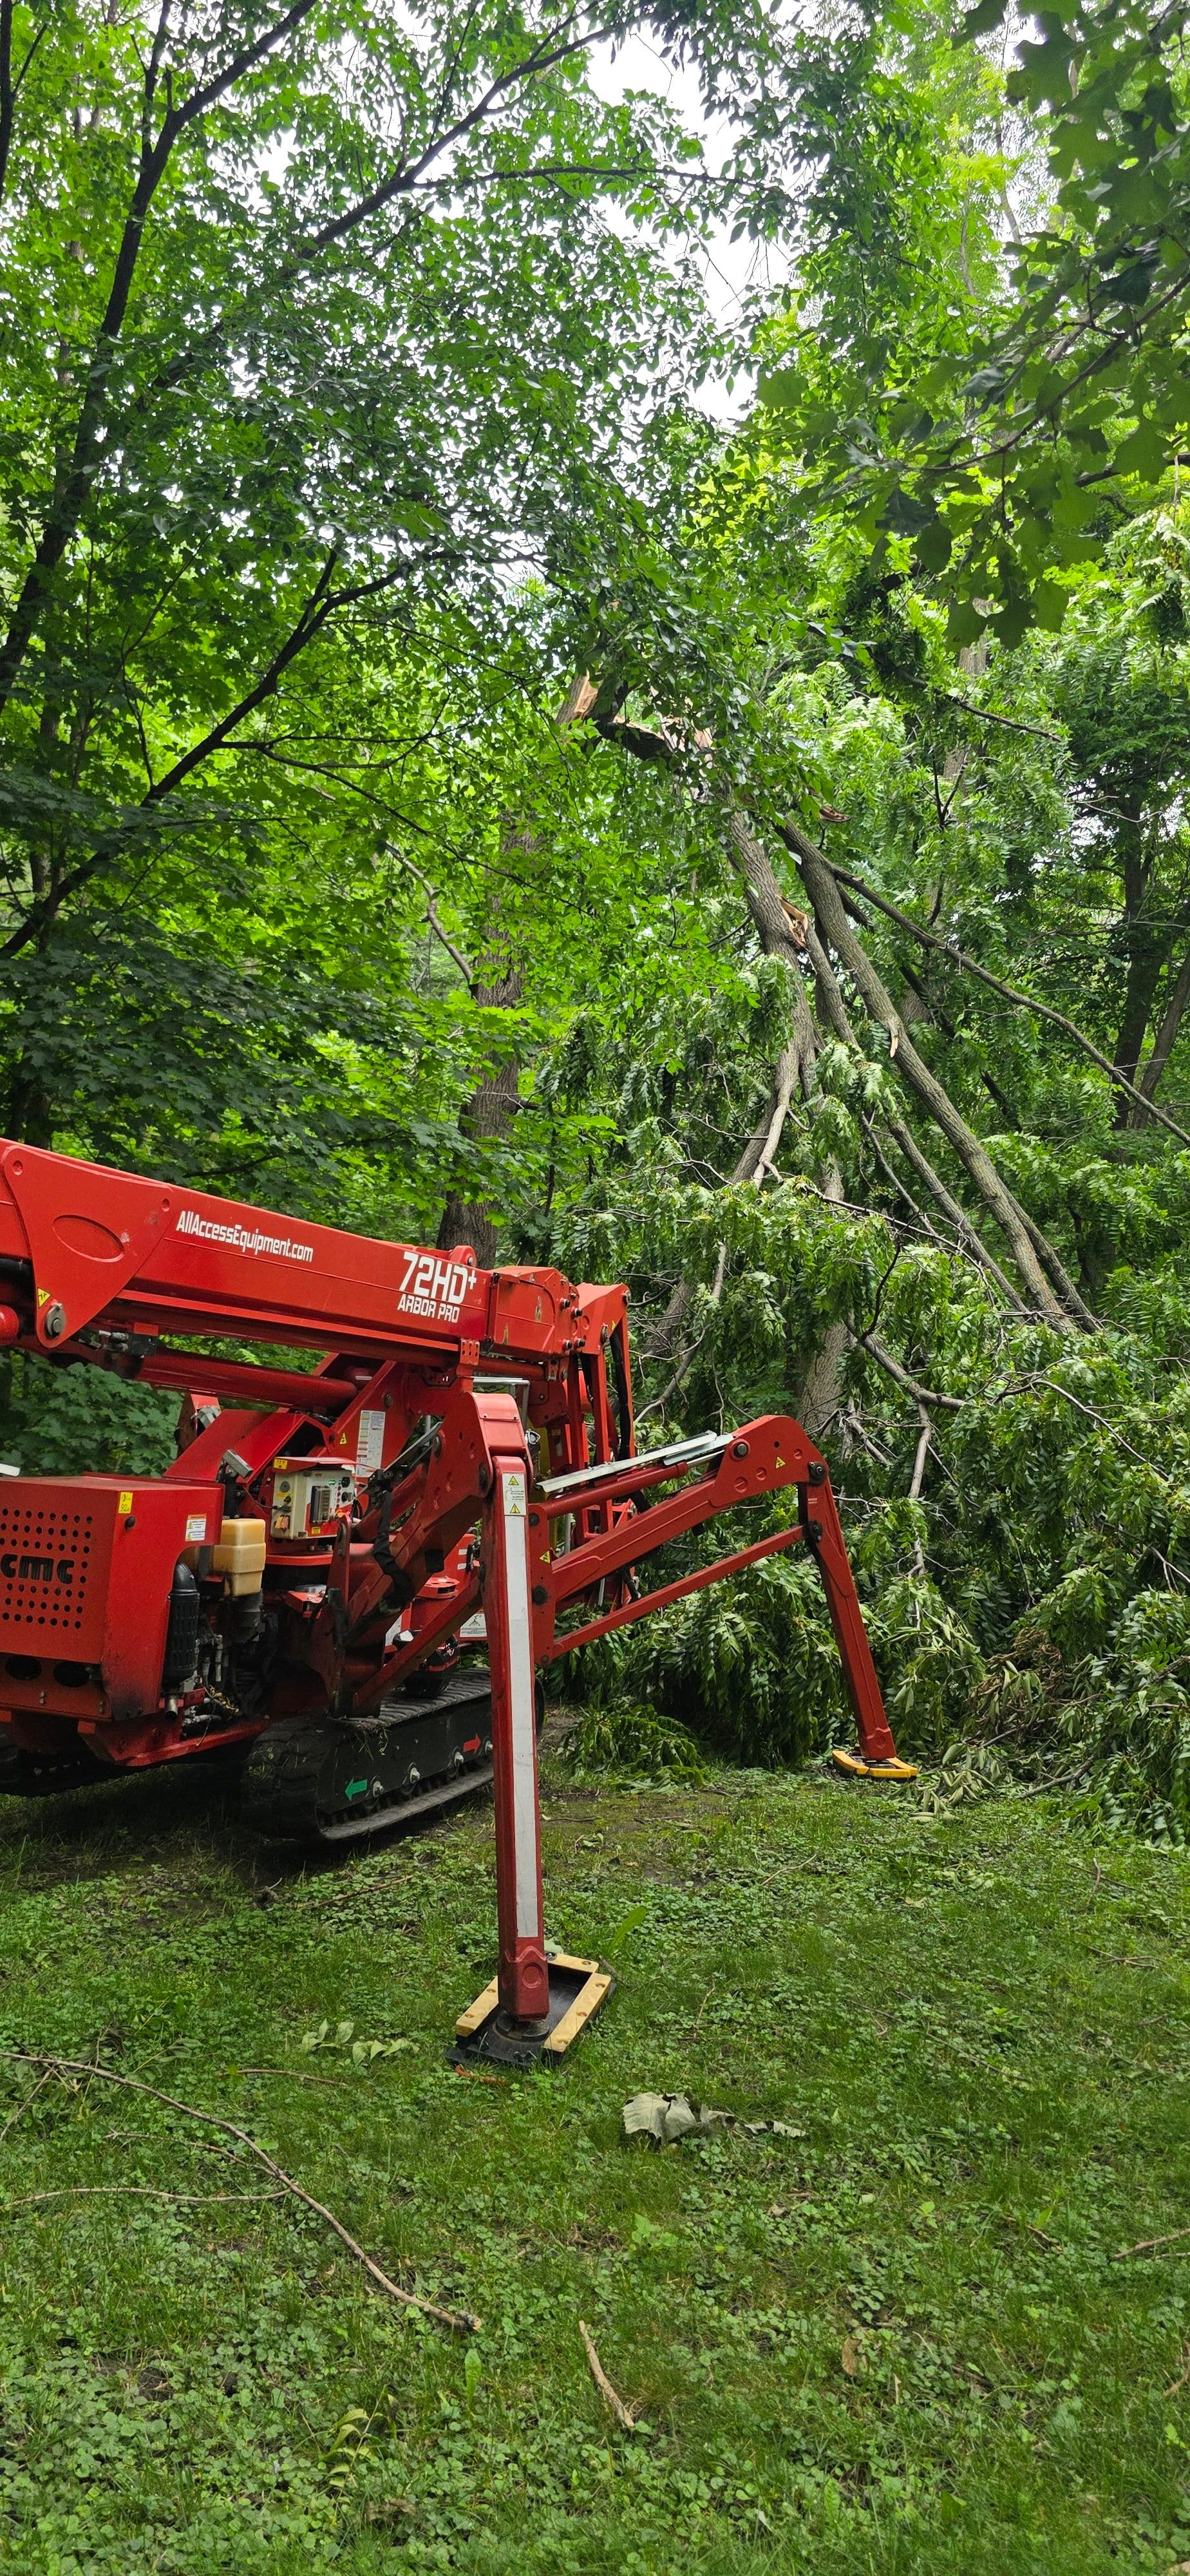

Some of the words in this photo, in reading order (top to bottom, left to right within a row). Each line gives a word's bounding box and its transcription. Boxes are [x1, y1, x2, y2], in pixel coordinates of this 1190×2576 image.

[176, 1210, 314, 1262] AllAccessEquipment.com
[399, 1251, 477, 1304] 72HD+
[397, 1293, 437, 1318] ARBOR
[437, 1303, 460, 1323] PRO
